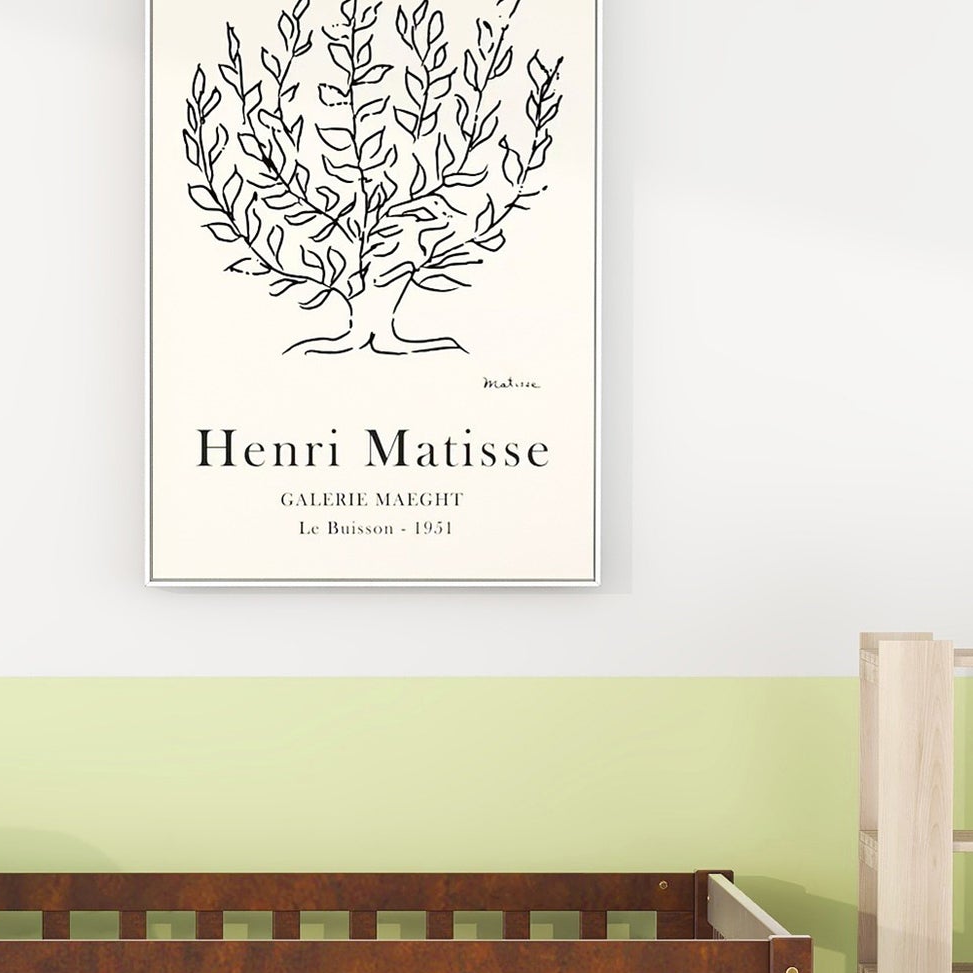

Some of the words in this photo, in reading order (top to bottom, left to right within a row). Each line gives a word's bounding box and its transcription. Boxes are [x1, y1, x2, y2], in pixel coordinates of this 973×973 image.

[196, 428, 340, 468] Henri
[365, 428, 550, 468] Matisse
[280, 492, 368, 507] GALERIE
[375, 492, 464, 507] MAEGHT
[298, 521, 320, 535] Le
[327, 521, 394, 535] Buisson
[414, 521, 452, 535] 1951
